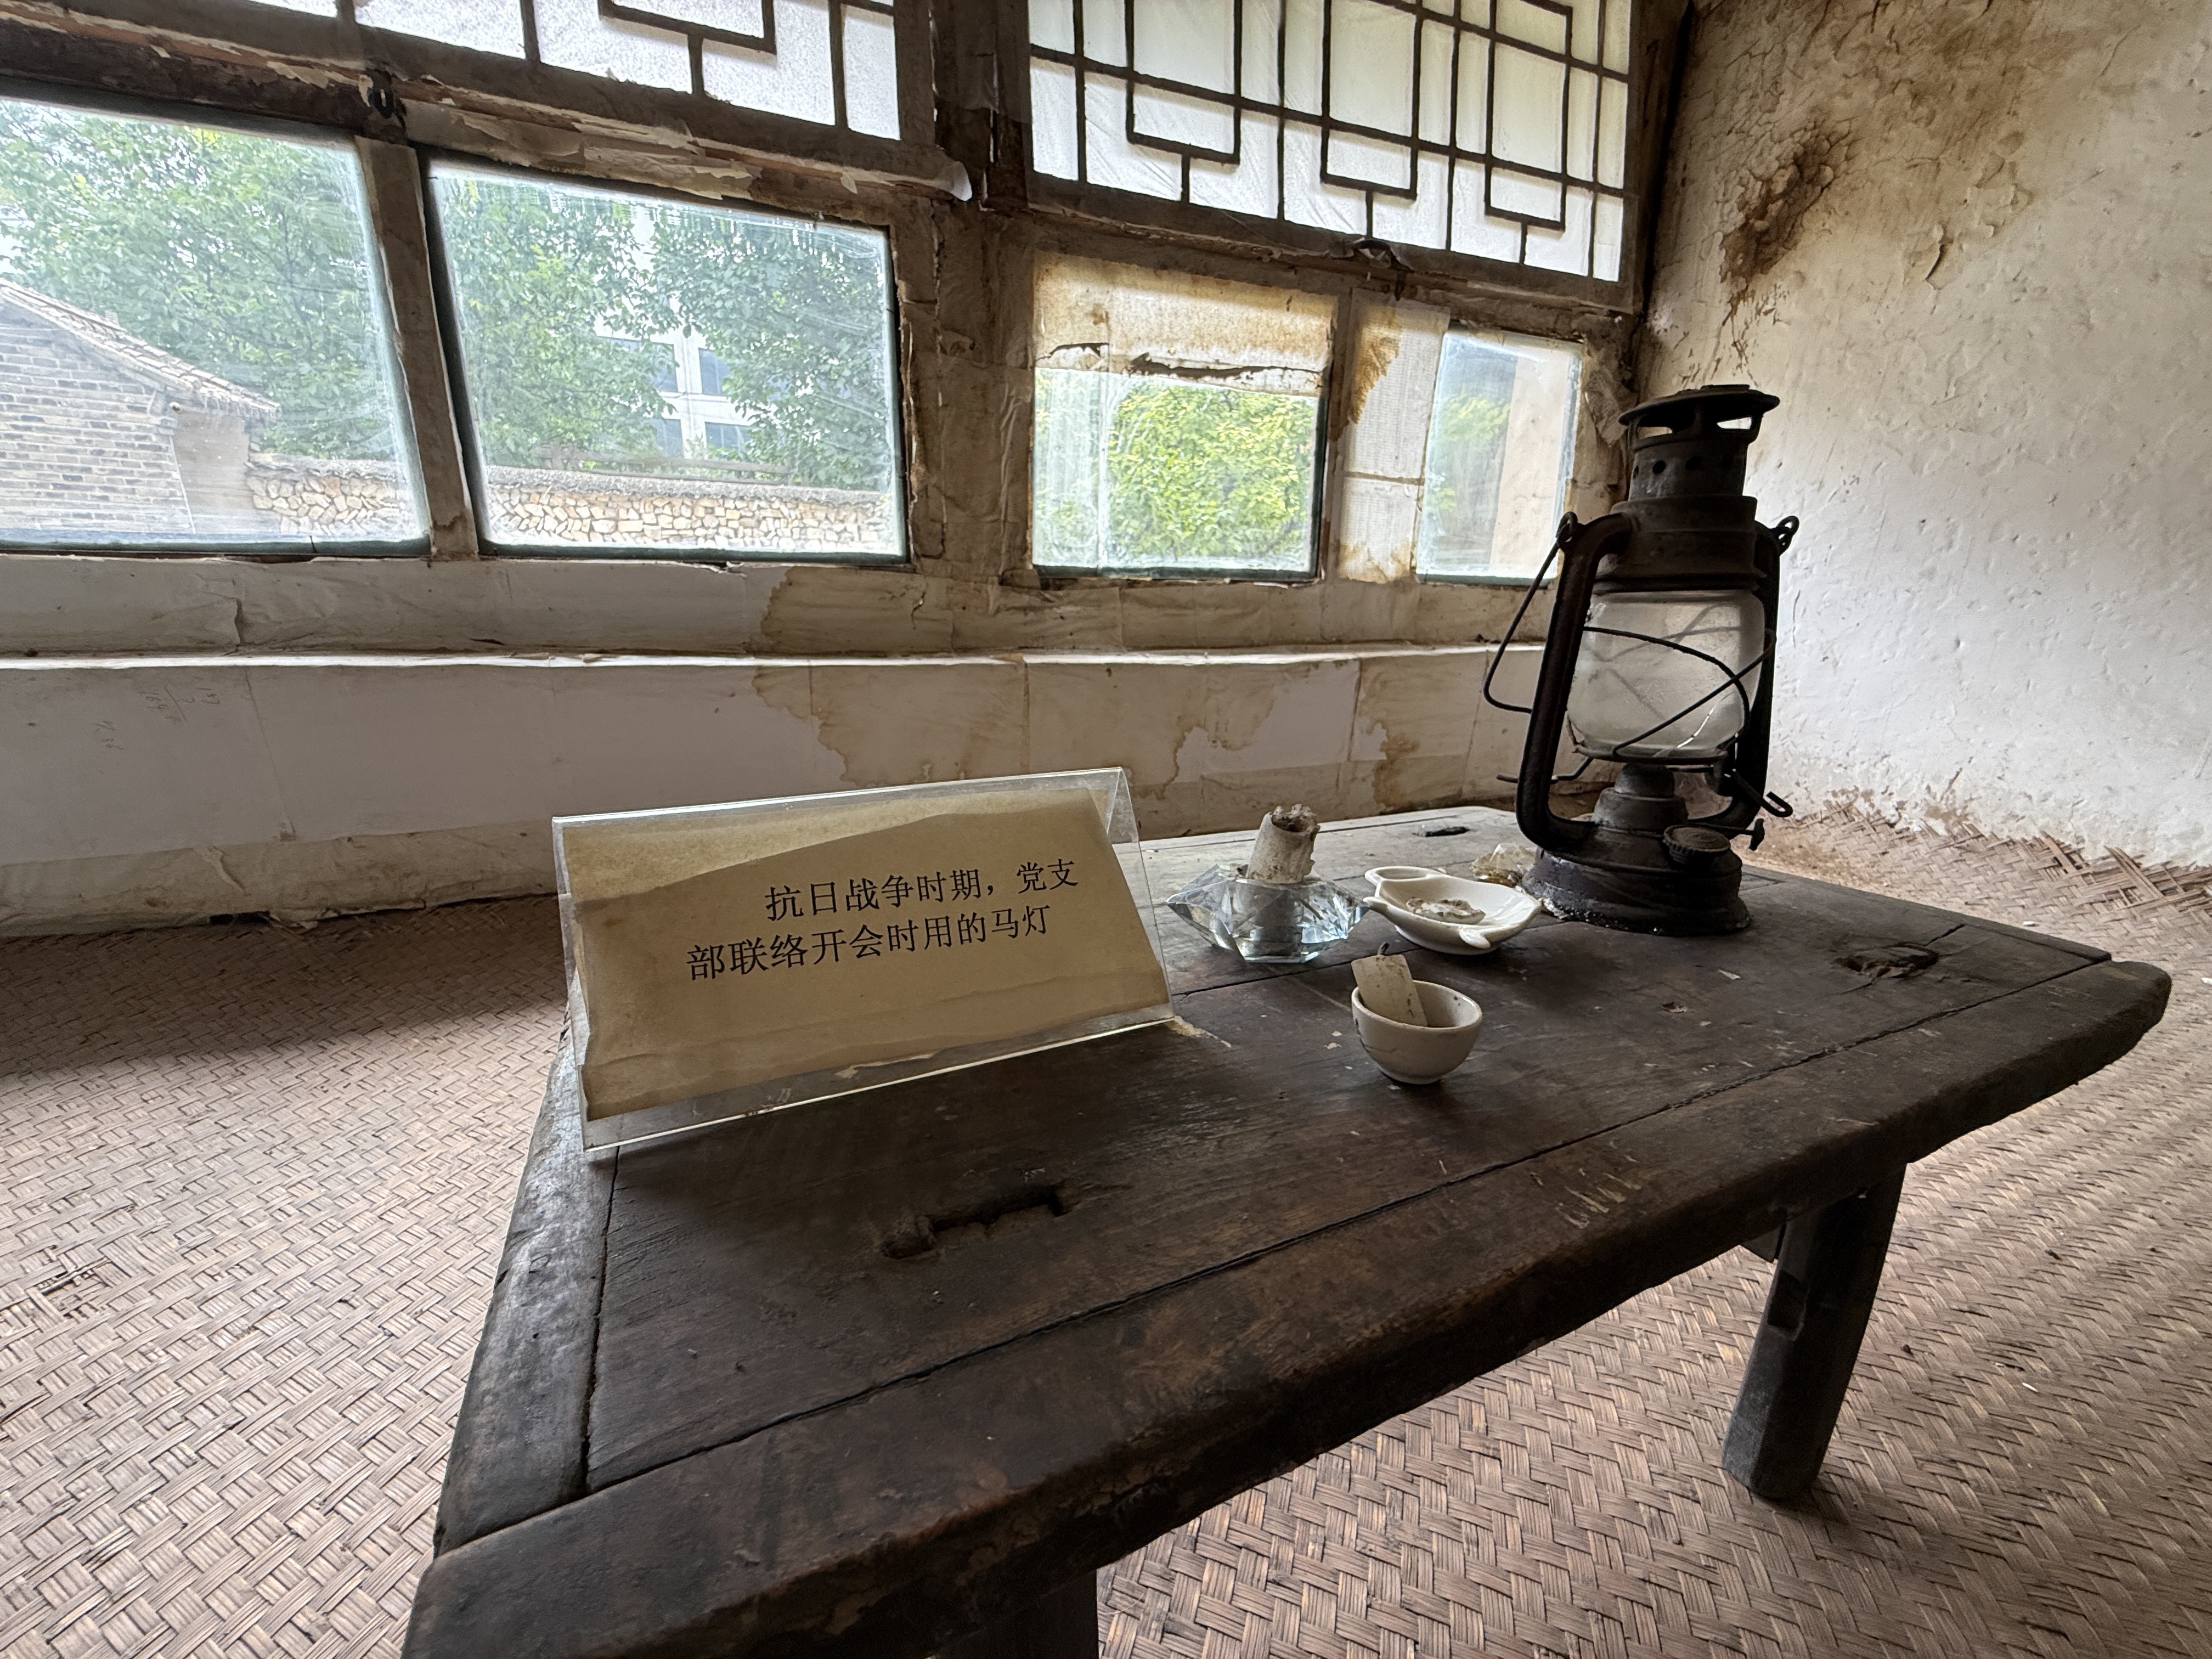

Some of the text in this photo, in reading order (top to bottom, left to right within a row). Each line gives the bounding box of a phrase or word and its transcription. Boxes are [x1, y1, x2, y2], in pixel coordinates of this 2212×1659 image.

[764, 857, 1079, 922] 抗日战争时期，党支
[685, 904, 1051, 981] 部联络开会时用的马灯
